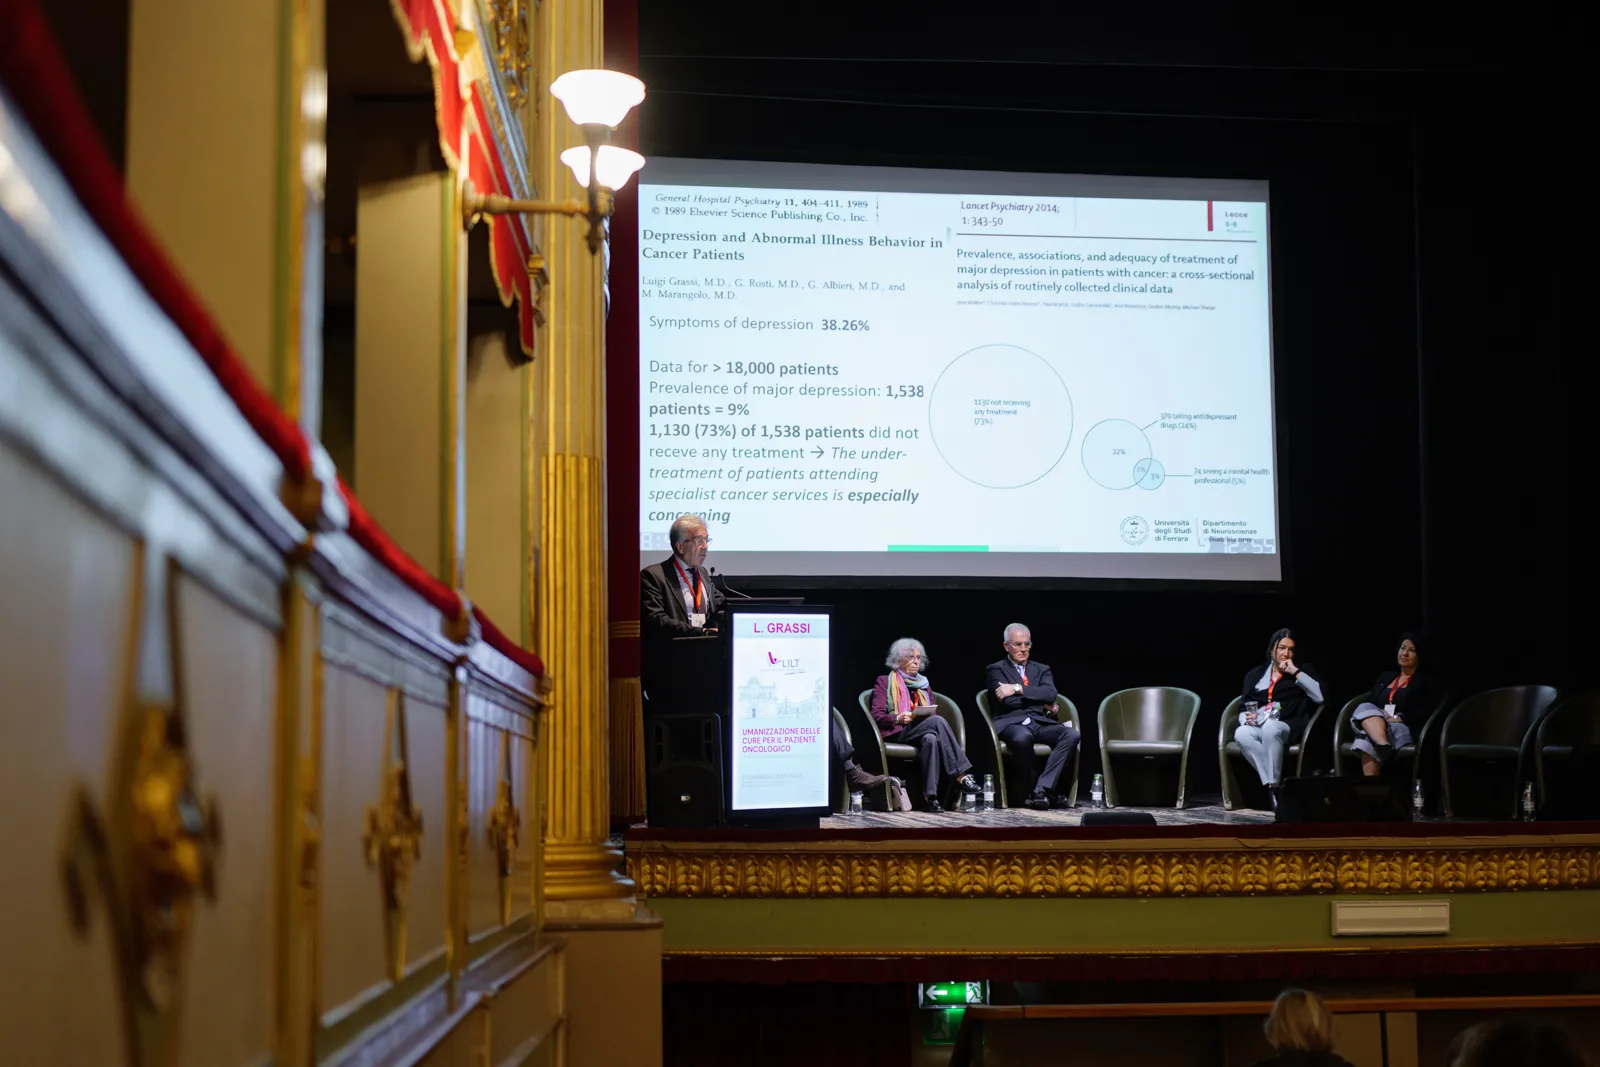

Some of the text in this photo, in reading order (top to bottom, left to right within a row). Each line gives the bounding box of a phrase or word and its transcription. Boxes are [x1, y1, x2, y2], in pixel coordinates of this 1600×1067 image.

[655, 193, 690, 203] General
[693, 194, 730, 206] Hospital
[734, 196, 780, 207] Psychiatry
[784, 198, 798, 207] 11,
[847, 200, 868, 208] 1989
[961, 201, 1060, 214] Lancet Psychiatry 2014;
[664, 207, 686, 216] 1989
[689, 207, 728, 218] Elsevier
[730, 208, 767, 218] Science
[770, 210, 823, 222] Publishing
[826, 212, 846, 222] Co.,
[850, 212, 867, 222] Inc.
[962, 217, 1003, 226] 1: 343-50
[642, 229, 943, 248] Depression and Abnormal Illness Behavior in
[642, 248, 744, 261] Cancer Patients
[957, 248, 1238, 265] Prevalence, associations, and adequacy of treatment of
[957, 266, 988, 277] major
[990, 266, 1046, 278] depression
[1049, 267, 1059, 276] in
[1061, 267, 1104, 279] patients
[1106, 268, 1130, 278] with
[1133, 270, 1169, 278] cancer:
[1179, 270, 1254, 280] cross-sectional
[642, 276, 905, 291] Luigi Grassi, M.D., G. Rosti, M.D., G. Albieri, M.D., and
[957, 280, 1173, 294] analysis of routinely collected clinical data
[642, 290, 737, 301] M. Marangolo, M.D.
[649, 316, 870, 332] Symptoms of depression 38.26%
[649, 360, 839, 378] Data for > 18,000 patients
[649, 381, 924, 399] Prevalence of major depression: 1,538
[649, 403, 710, 417] patients
[727, 403, 750, 415] 9%
[974, 399, 989, 407] 1130
[1003, 399, 1030, 408] receiving
[649, 423, 919, 440] 1,130 (73%) of 1,538 patients did not
[649, 447, 907, 460] receve any treatment The under-
[649, 467, 879, 483] treatment of patients attending
[649, 488, 919, 505] specialist cancer services is especially
[648, 509, 731, 524] concning
[754, 622, 810, 634] L. GRASSI
[782, 658, 800, 668] LILT
[742, 728, 799, 736] UMANIZZAZIONE
